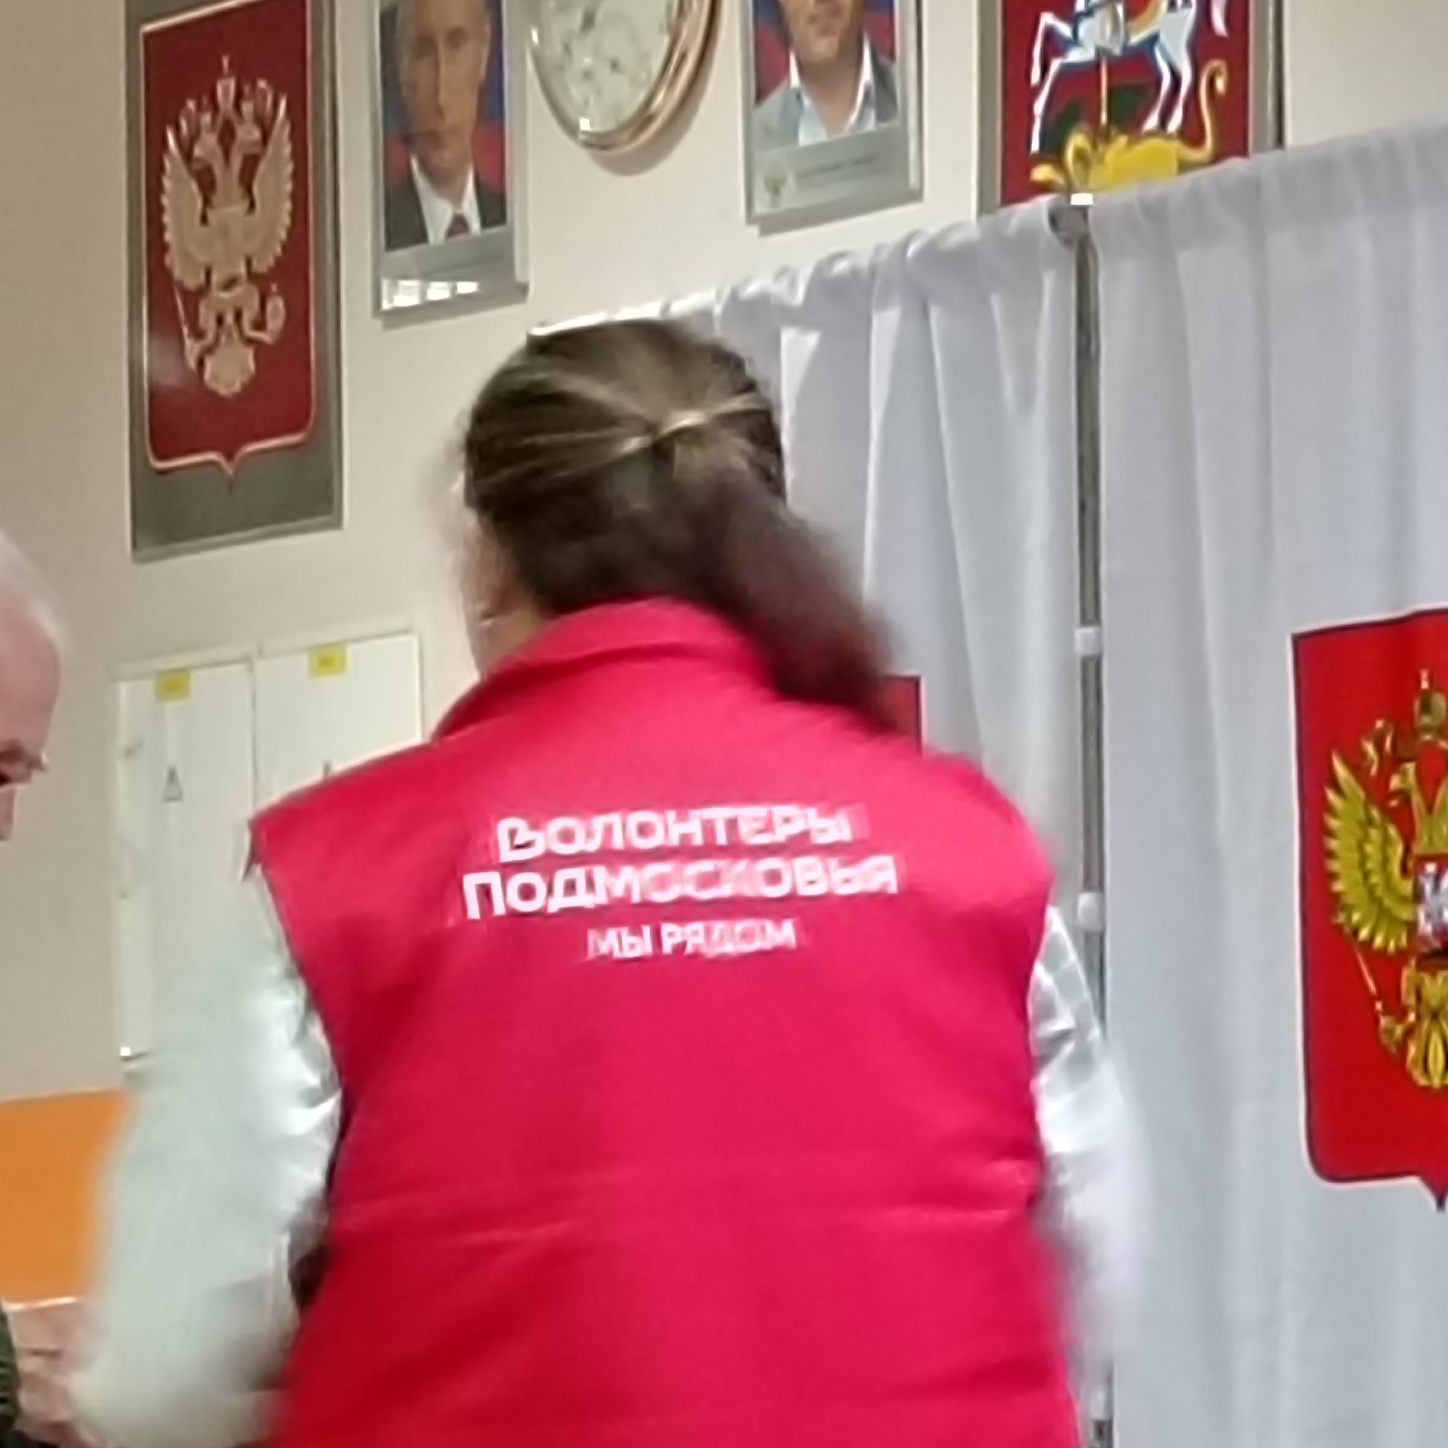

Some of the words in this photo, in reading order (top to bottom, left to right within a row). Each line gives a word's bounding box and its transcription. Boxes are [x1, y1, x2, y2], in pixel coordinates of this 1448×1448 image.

[496, 805, 854, 863] ВОЛОНТЕРЫ
[462, 855, 898, 920] ПОДМОСКОВЬЯ
[586, 924, 653, 959] МЫ
[660, 918, 797, 958] РЯДОМ
